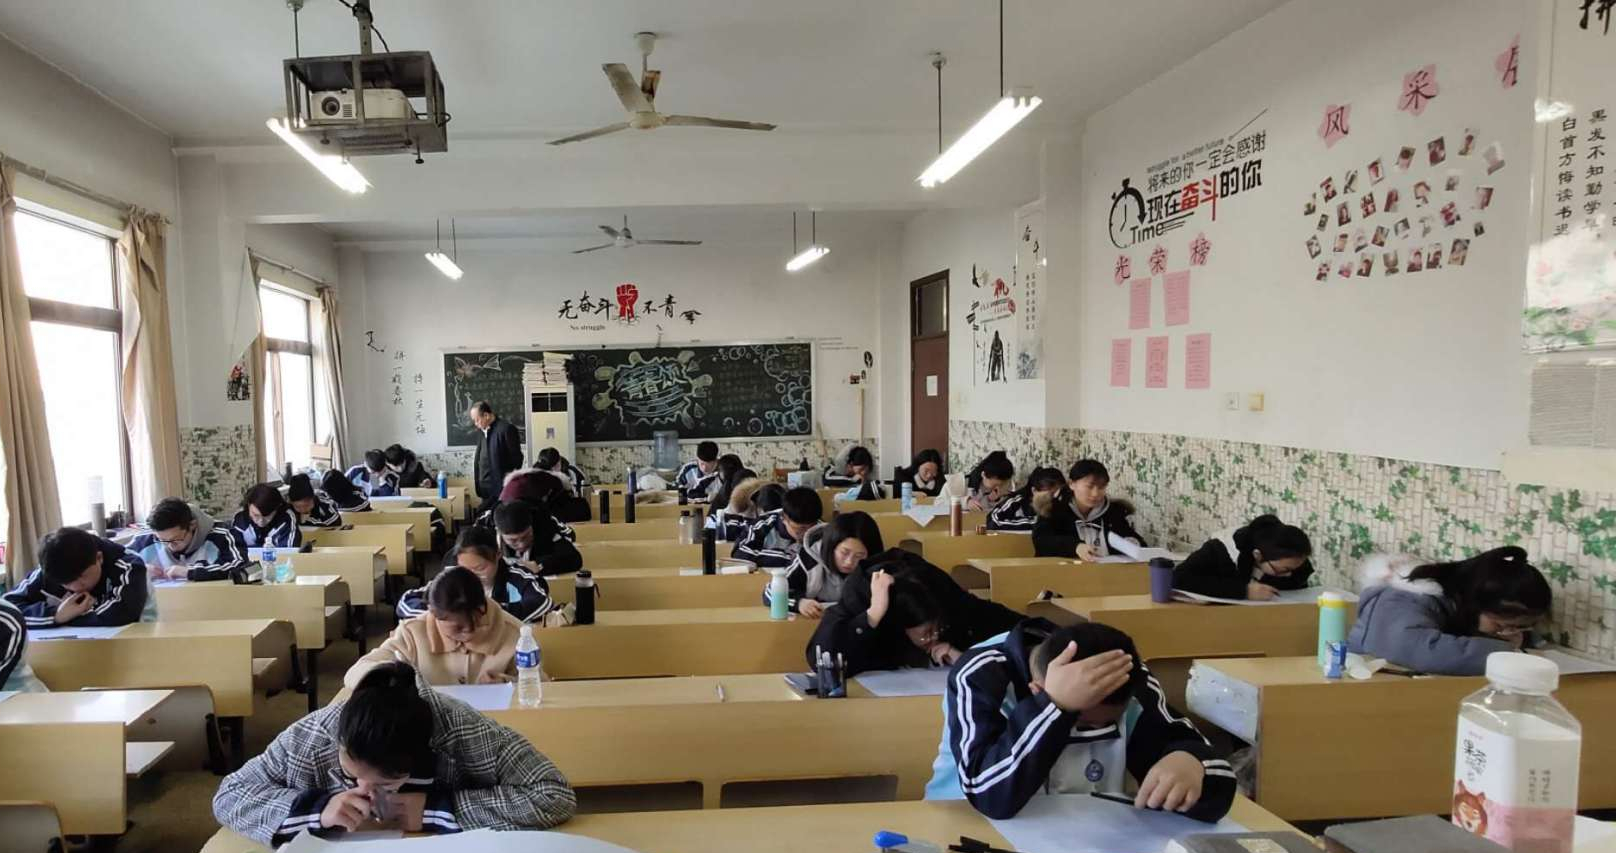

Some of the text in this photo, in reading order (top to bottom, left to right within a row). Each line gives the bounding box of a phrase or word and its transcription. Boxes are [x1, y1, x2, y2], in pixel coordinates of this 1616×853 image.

[1147, 130, 1266, 192] 将来的你一定会感谢
[1147, 159, 1262, 224] 现在奋斗的你
[1130, 222, 1164, 245] Time
